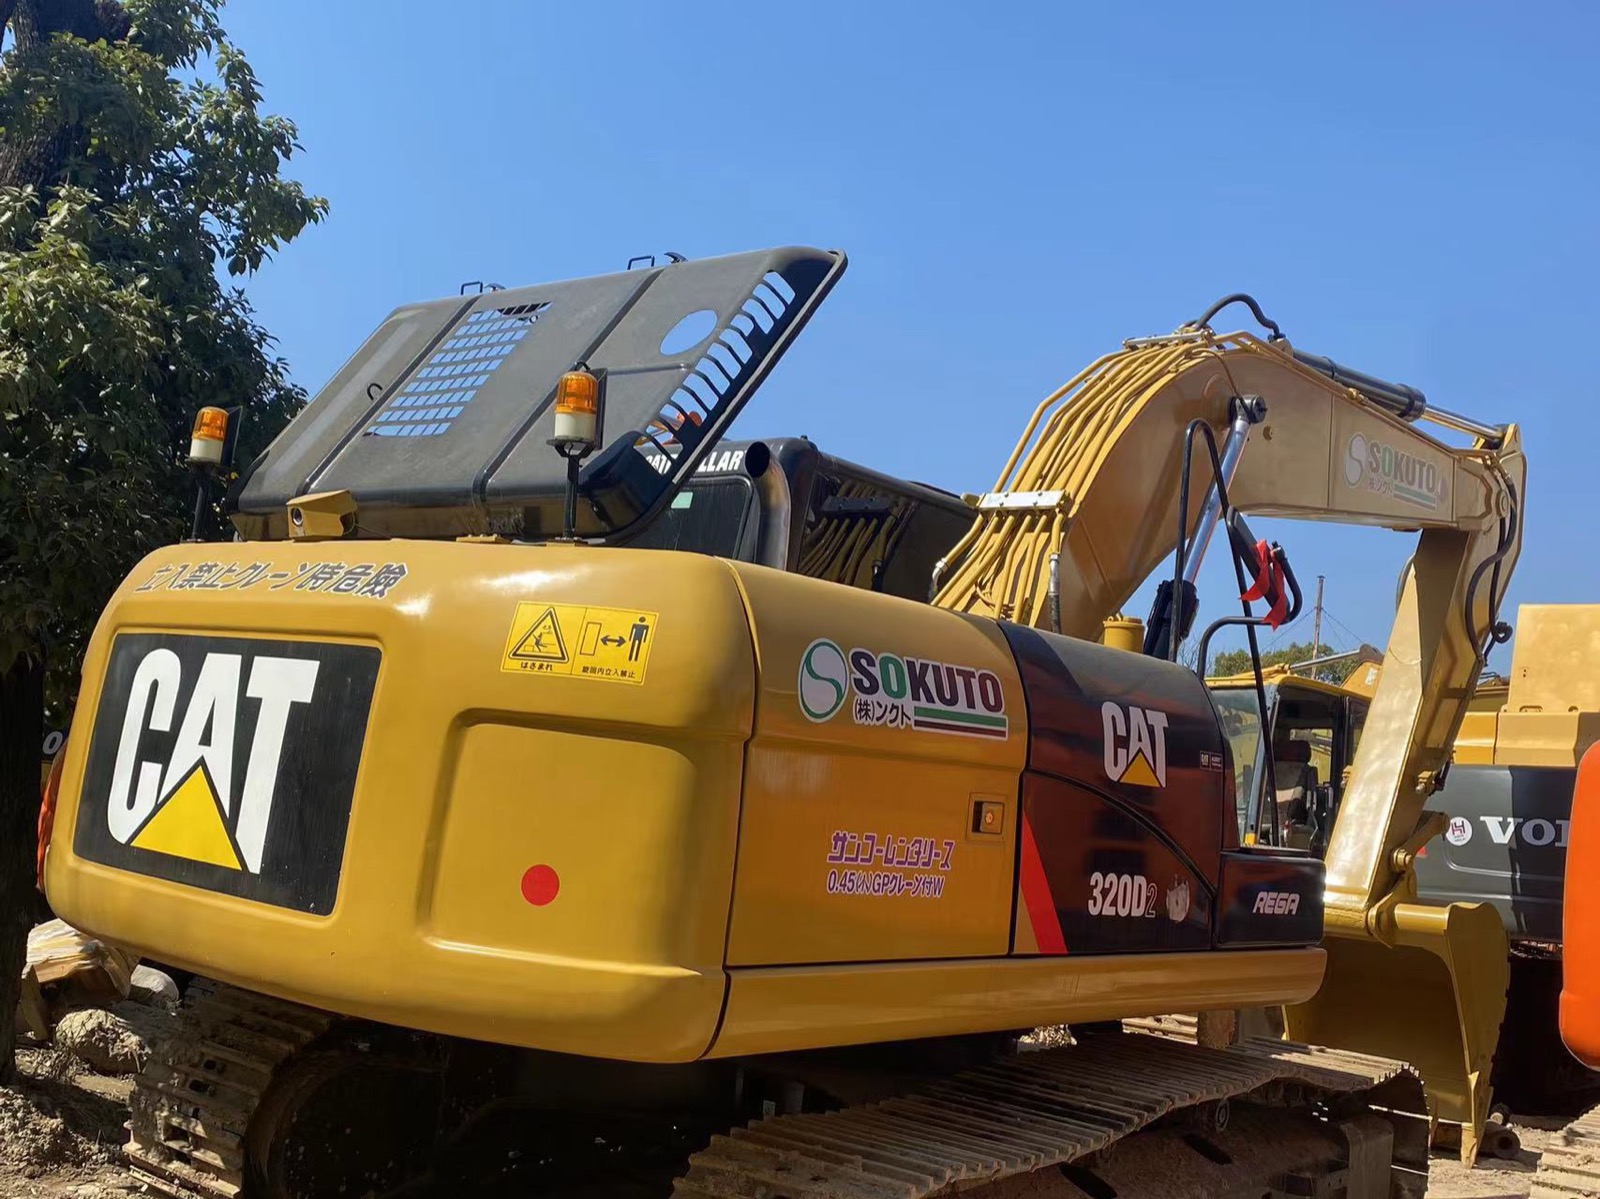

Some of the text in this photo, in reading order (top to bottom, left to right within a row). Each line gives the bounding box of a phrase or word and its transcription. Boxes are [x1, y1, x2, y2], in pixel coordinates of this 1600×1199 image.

[1368, 441, 1437, 493] SOKUTO
[850, 650, 1004, 713] SOKUTO
[107, 648, 320, 875] CAT
[1101, 701, 1169, 789] CAT
[1252, 890, 1300, 916] REGA
